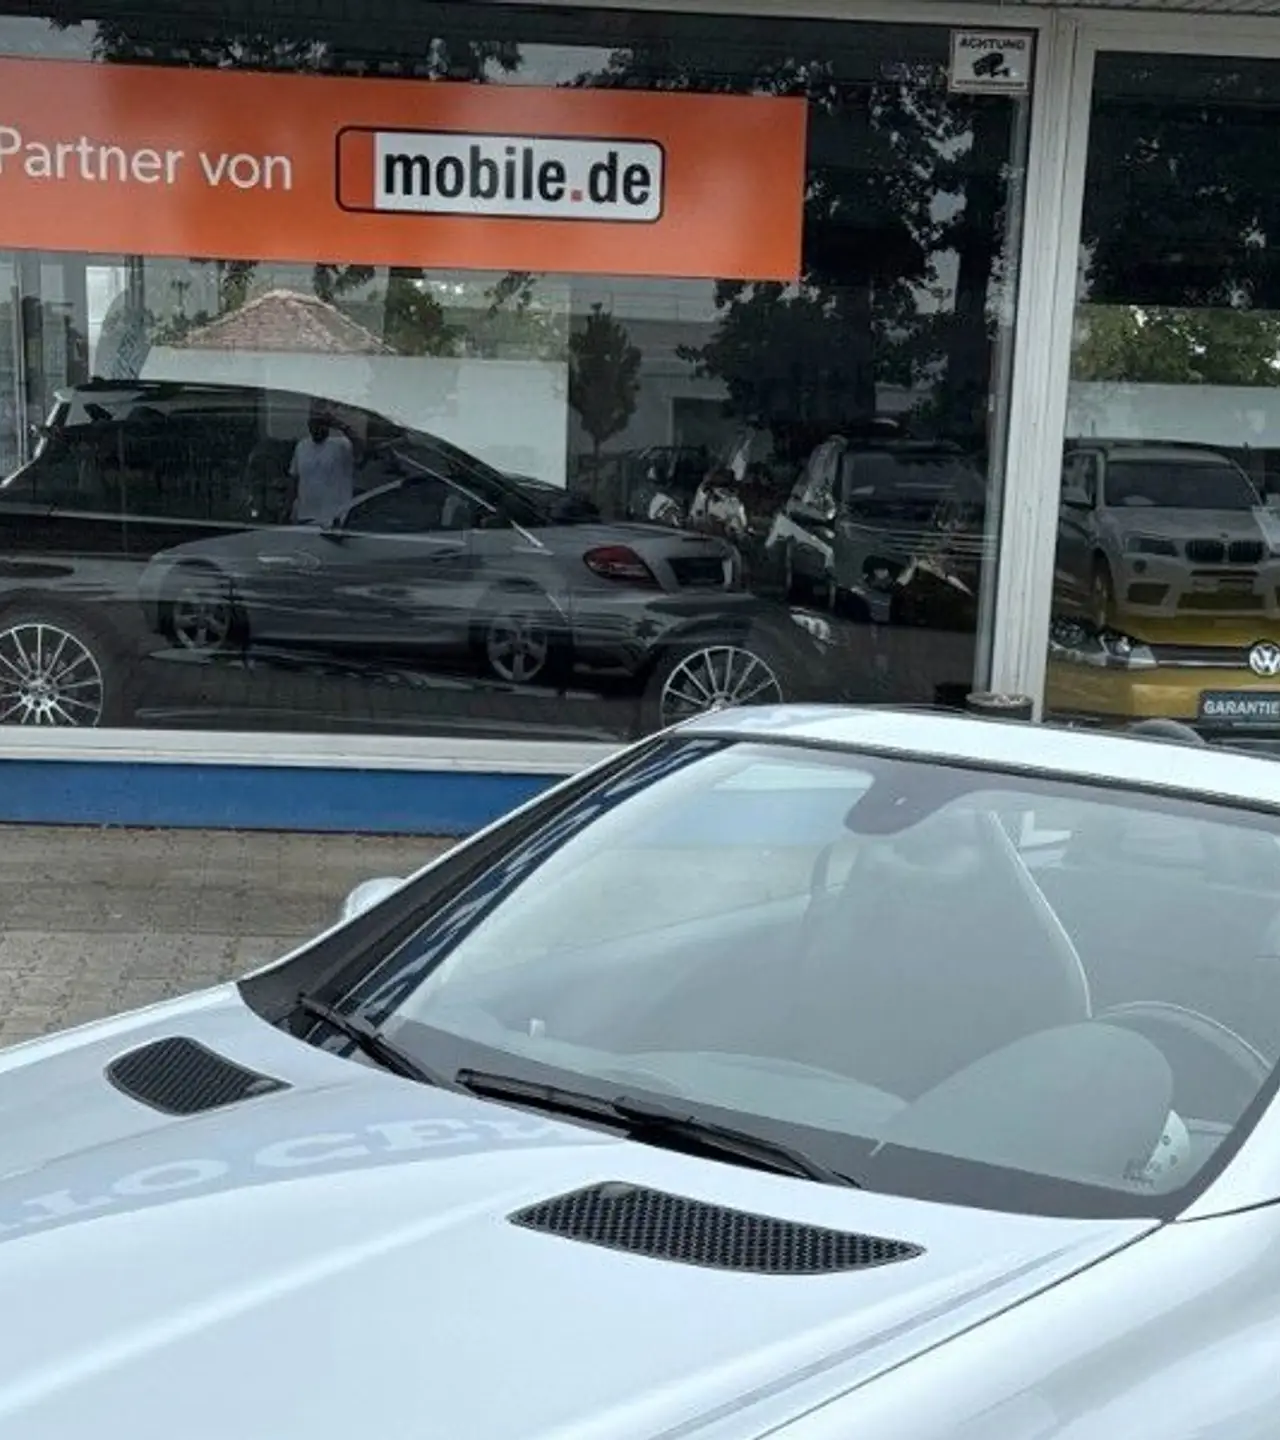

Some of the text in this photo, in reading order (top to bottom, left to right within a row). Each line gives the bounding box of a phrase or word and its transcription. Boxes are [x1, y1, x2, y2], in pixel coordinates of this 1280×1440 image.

[199, 151, 293, 191] von
[383, 144, 652, 206] mobile.de
[1203, 700, 1280, 715] GARANTIE
